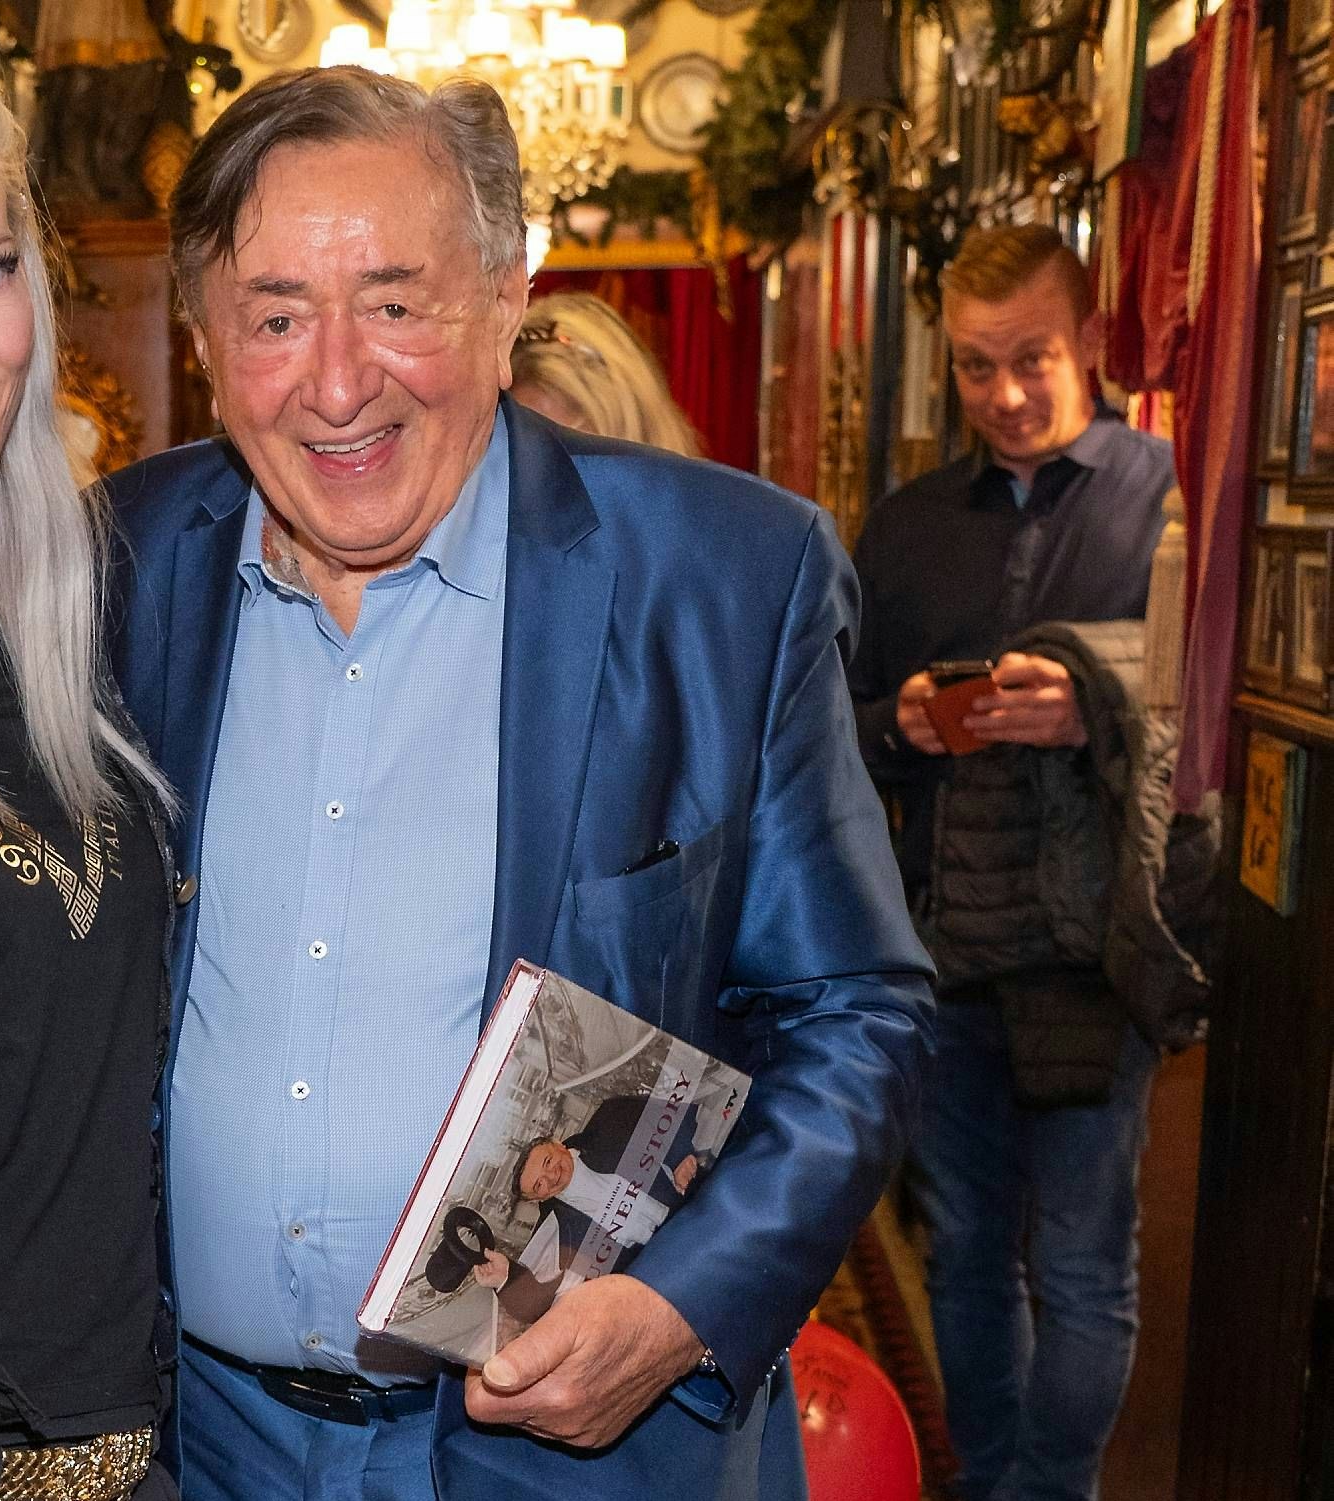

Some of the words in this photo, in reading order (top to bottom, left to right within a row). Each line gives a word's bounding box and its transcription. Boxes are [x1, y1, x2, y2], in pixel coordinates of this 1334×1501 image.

[97, 799, 123, 881] ITALI
[722, 1087, 738, 1121] ATV
[584, 1177, 644, 1282] UGNER
[640, 1071, 691, 1171] STORY
